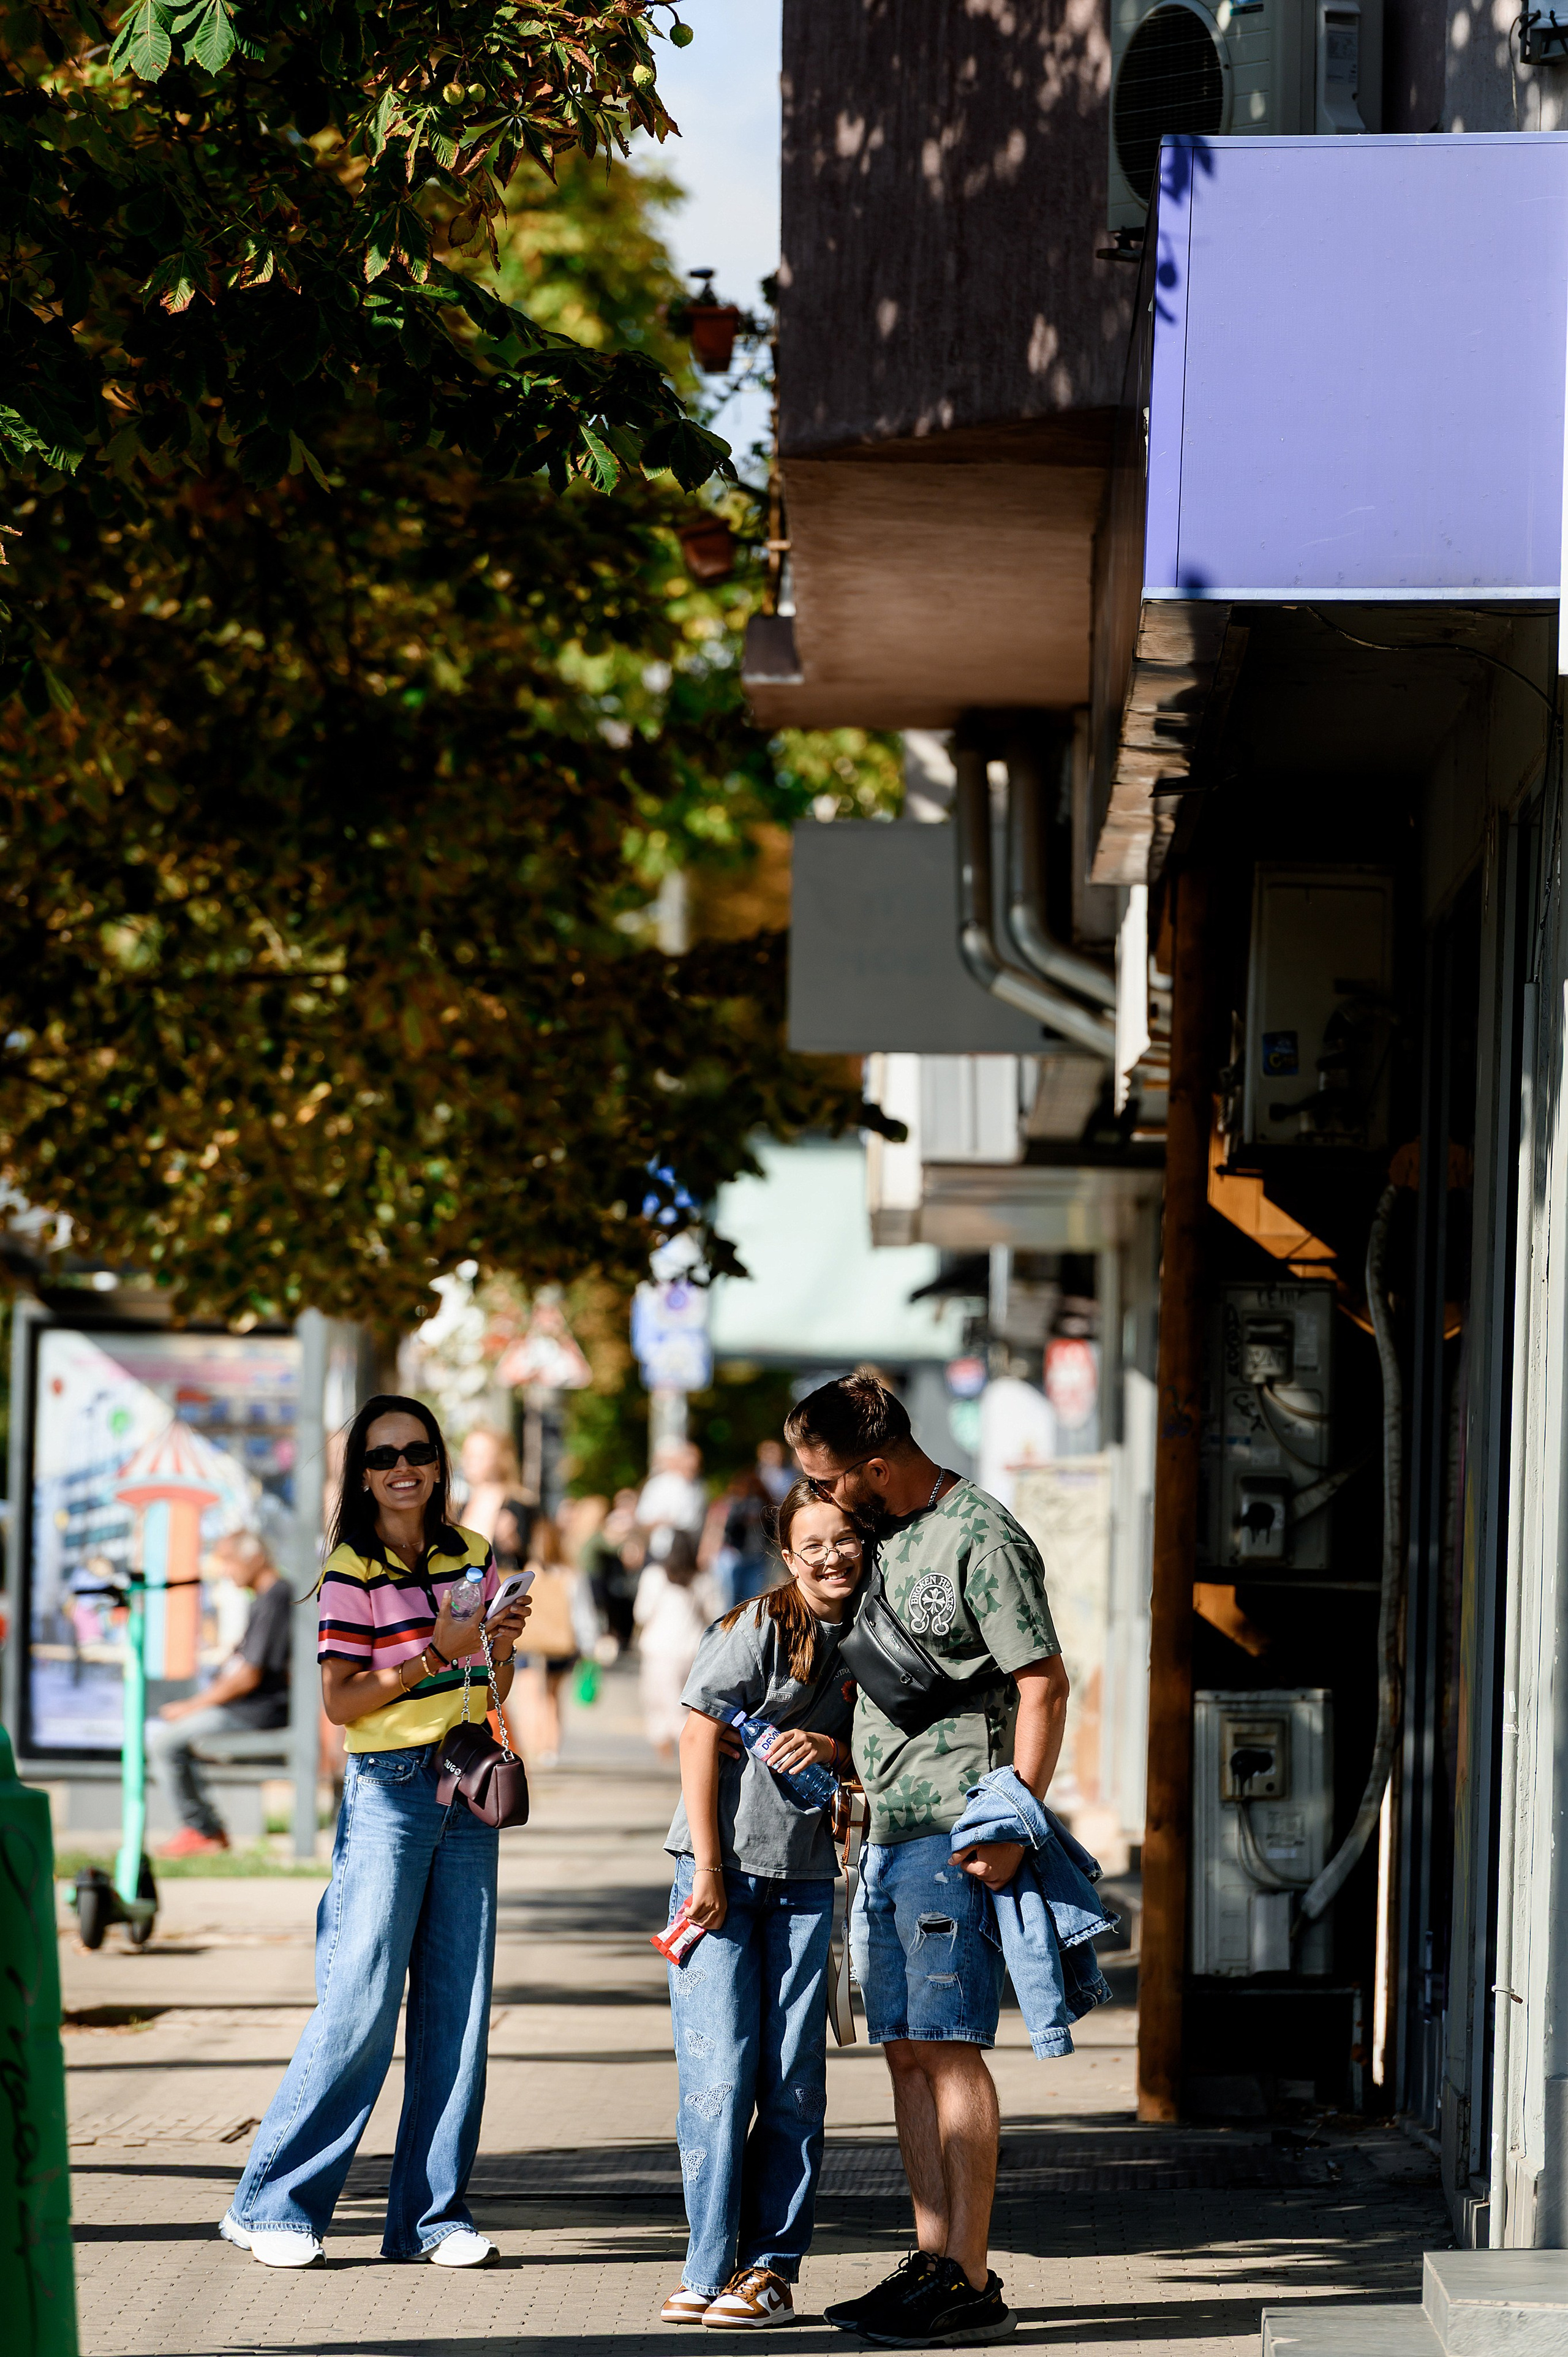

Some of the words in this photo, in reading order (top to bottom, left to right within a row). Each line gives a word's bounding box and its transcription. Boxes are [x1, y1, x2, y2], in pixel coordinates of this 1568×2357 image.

[911, 1575, 937, 1605] BROKEN
[938, 1577, 954, 1612] HEARTS
[761, 1729, 781, 1751] DEVIN
